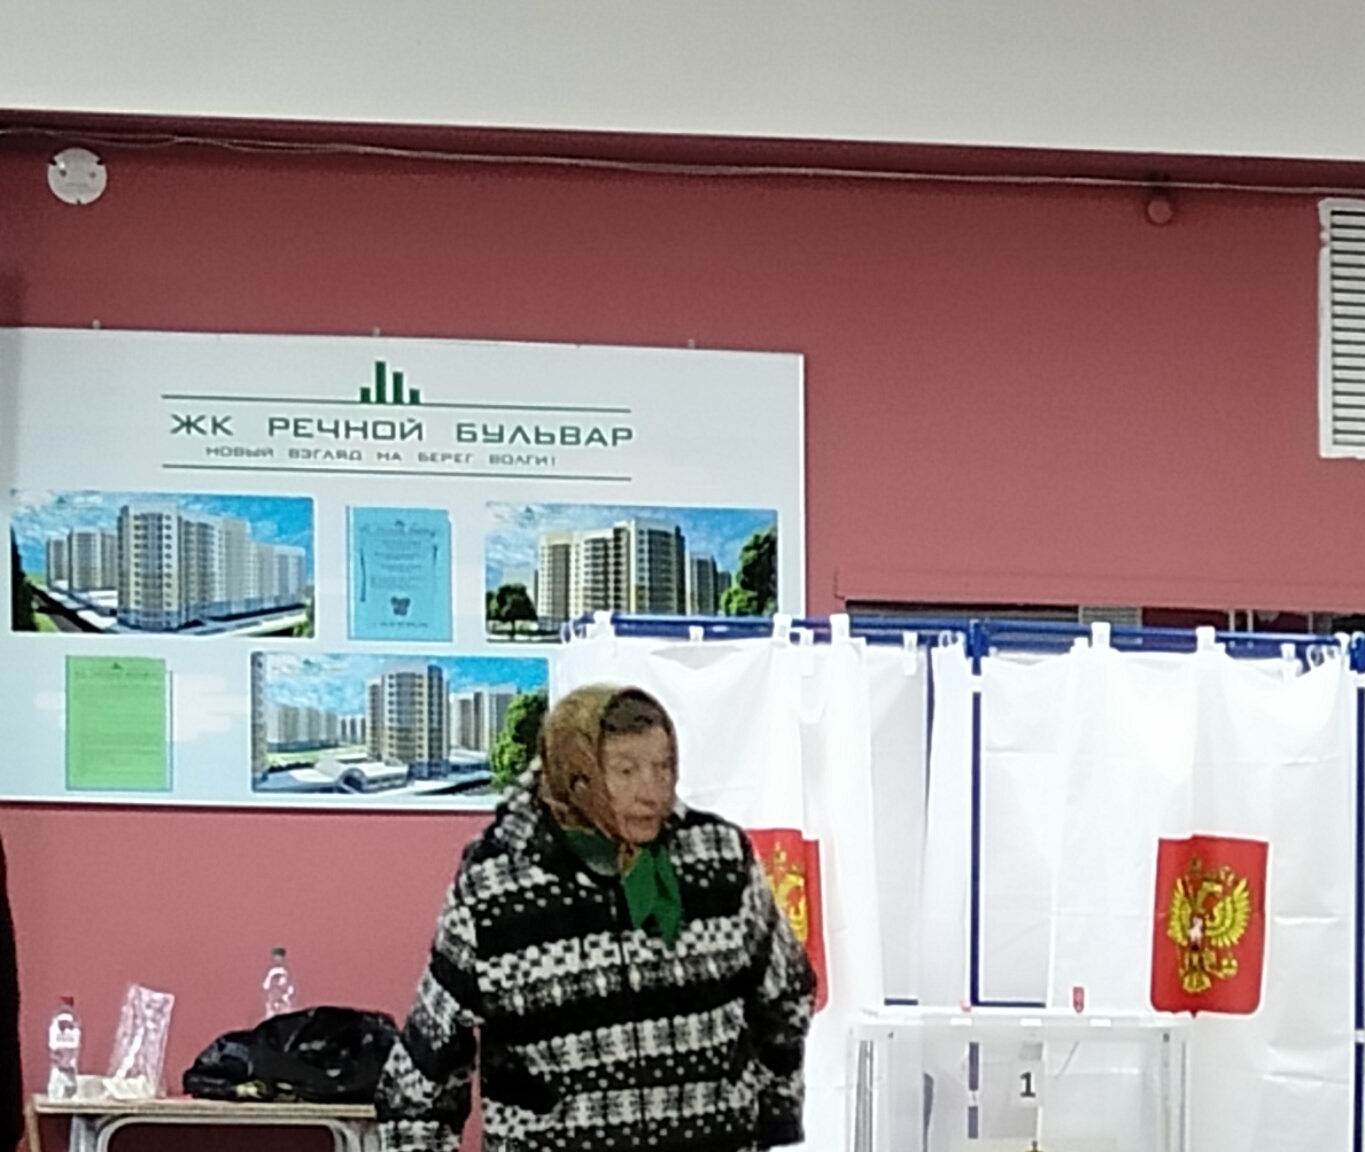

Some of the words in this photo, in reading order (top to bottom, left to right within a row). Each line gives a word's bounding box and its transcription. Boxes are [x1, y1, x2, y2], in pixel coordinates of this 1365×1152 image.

[170, 413, 234, 437] ЖК
[268, 416, 423, 442] РЕЧНОЙ
[456, 422, 633, 447] БУЛЬВАР
[205, 446, 274, 458] НОВЫЙ
[287, 447, 363, 461] ВЗГЛЯД
[376, 451, 402, 461] НА
[417, 451, 473, 464] БЕРЕГ
[488, 453, 556, 467] ВОЛГИ!
[1020, 1071, 1036, 1098] 1
